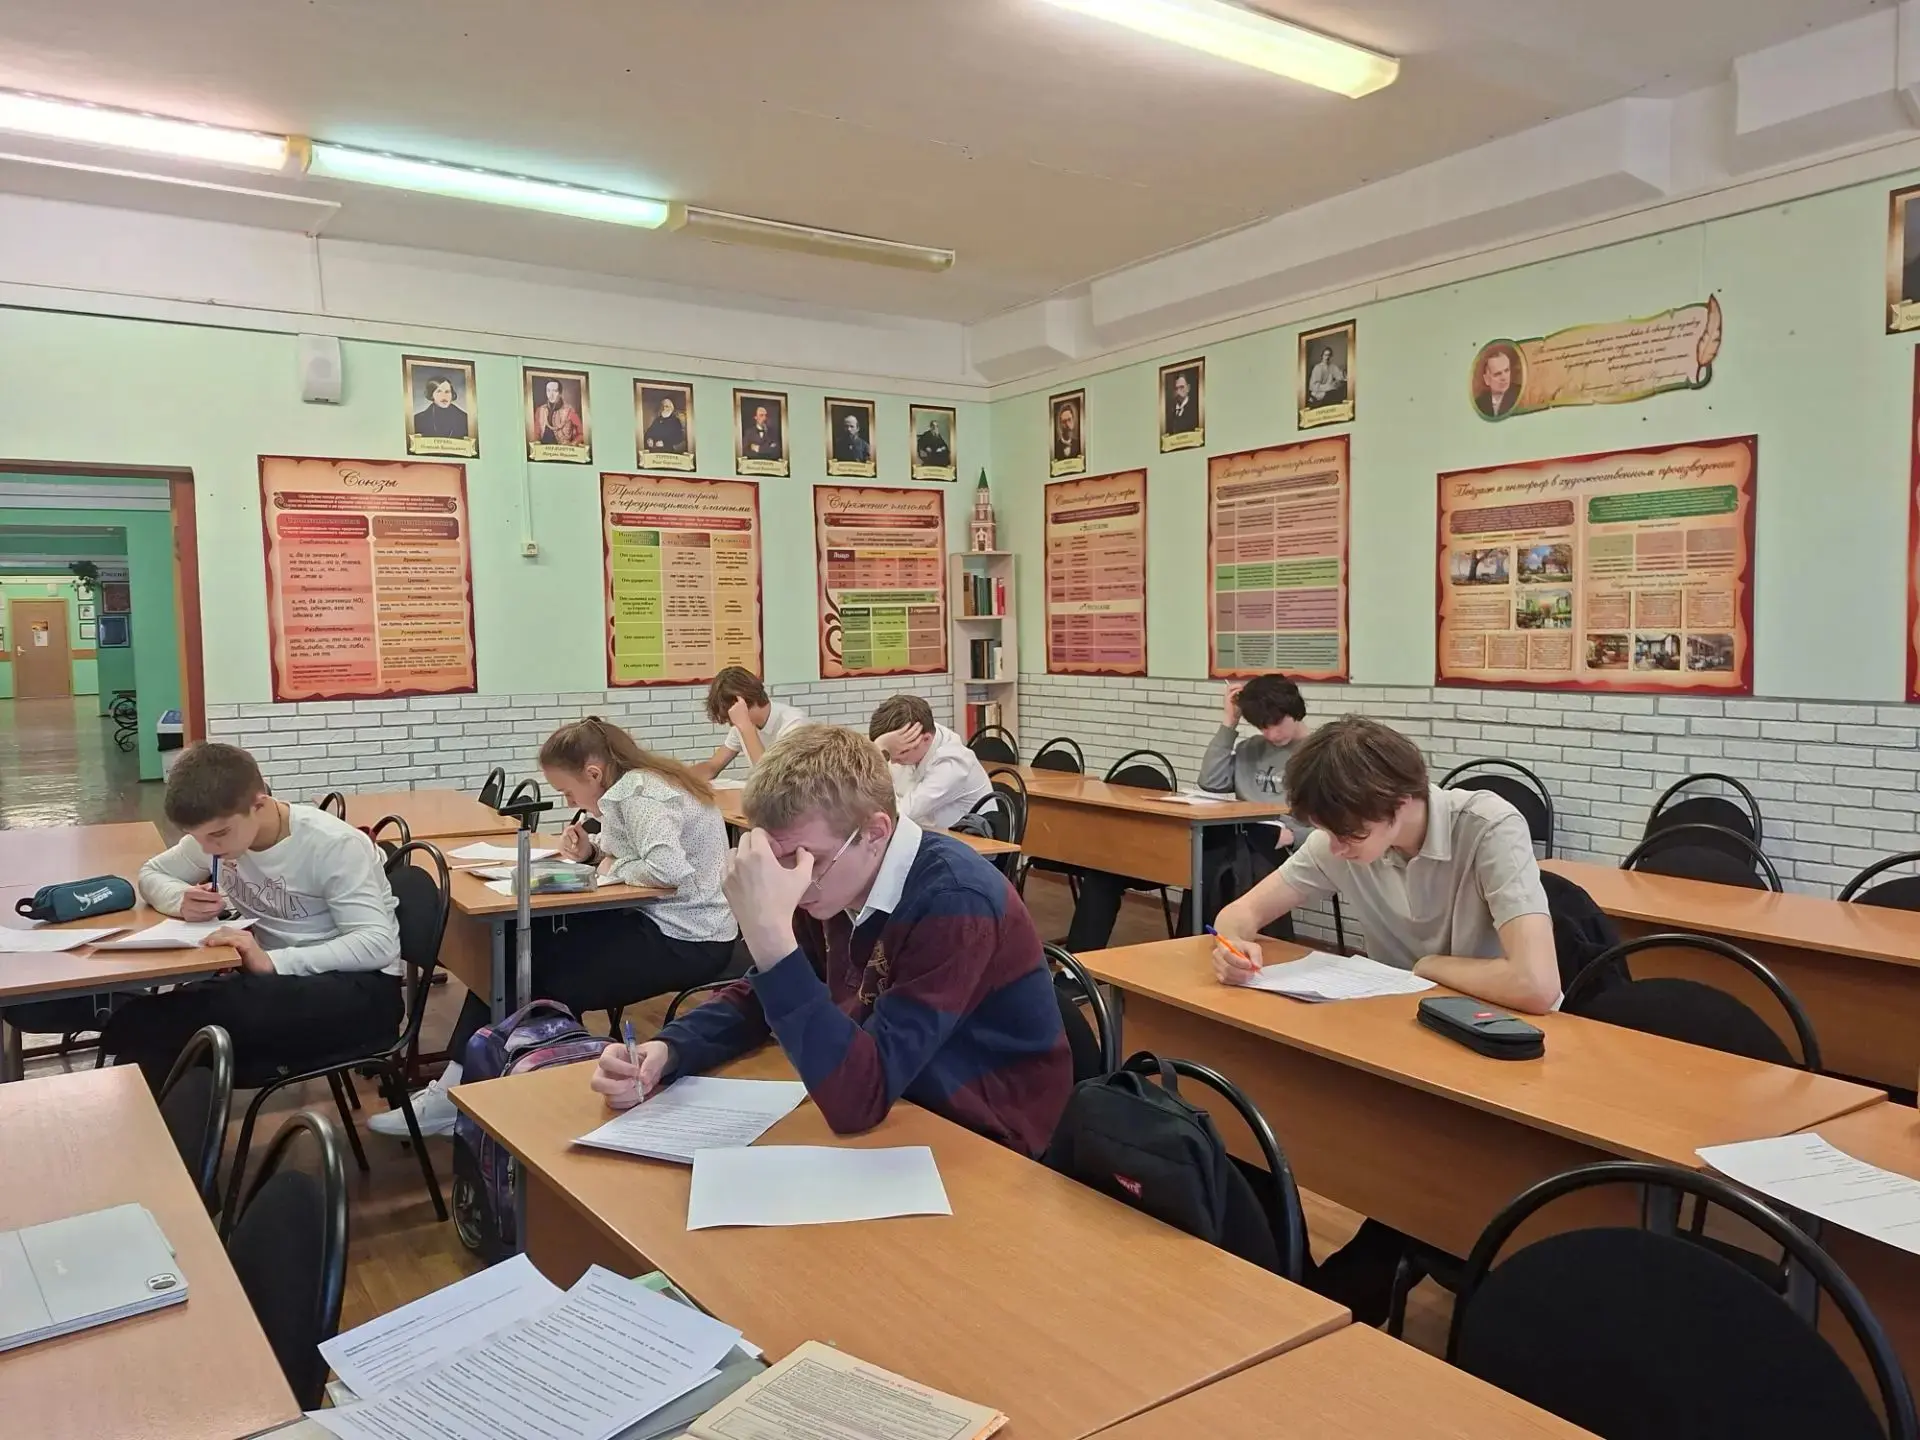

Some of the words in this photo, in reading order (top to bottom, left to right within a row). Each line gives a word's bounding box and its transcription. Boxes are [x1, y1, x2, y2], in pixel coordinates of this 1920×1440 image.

[338, 469, 399, 493] Союзы
[1504, 478, 1549, 494] интерьер
[1551, 474, 1561, 486] в
[1559, 467, 1655, 491] художественном
[1658, 457, 1736, 481] произведении
[607, 483, 685, 499] Правописание
[686, 491, 719, 503] корней
[827, 494, 890, 512] Спряжение
[891, 500, 935, 511] глаголов
[618, 500, 699, 511] чередующимися
[702, 504, 751, 513] гласными
